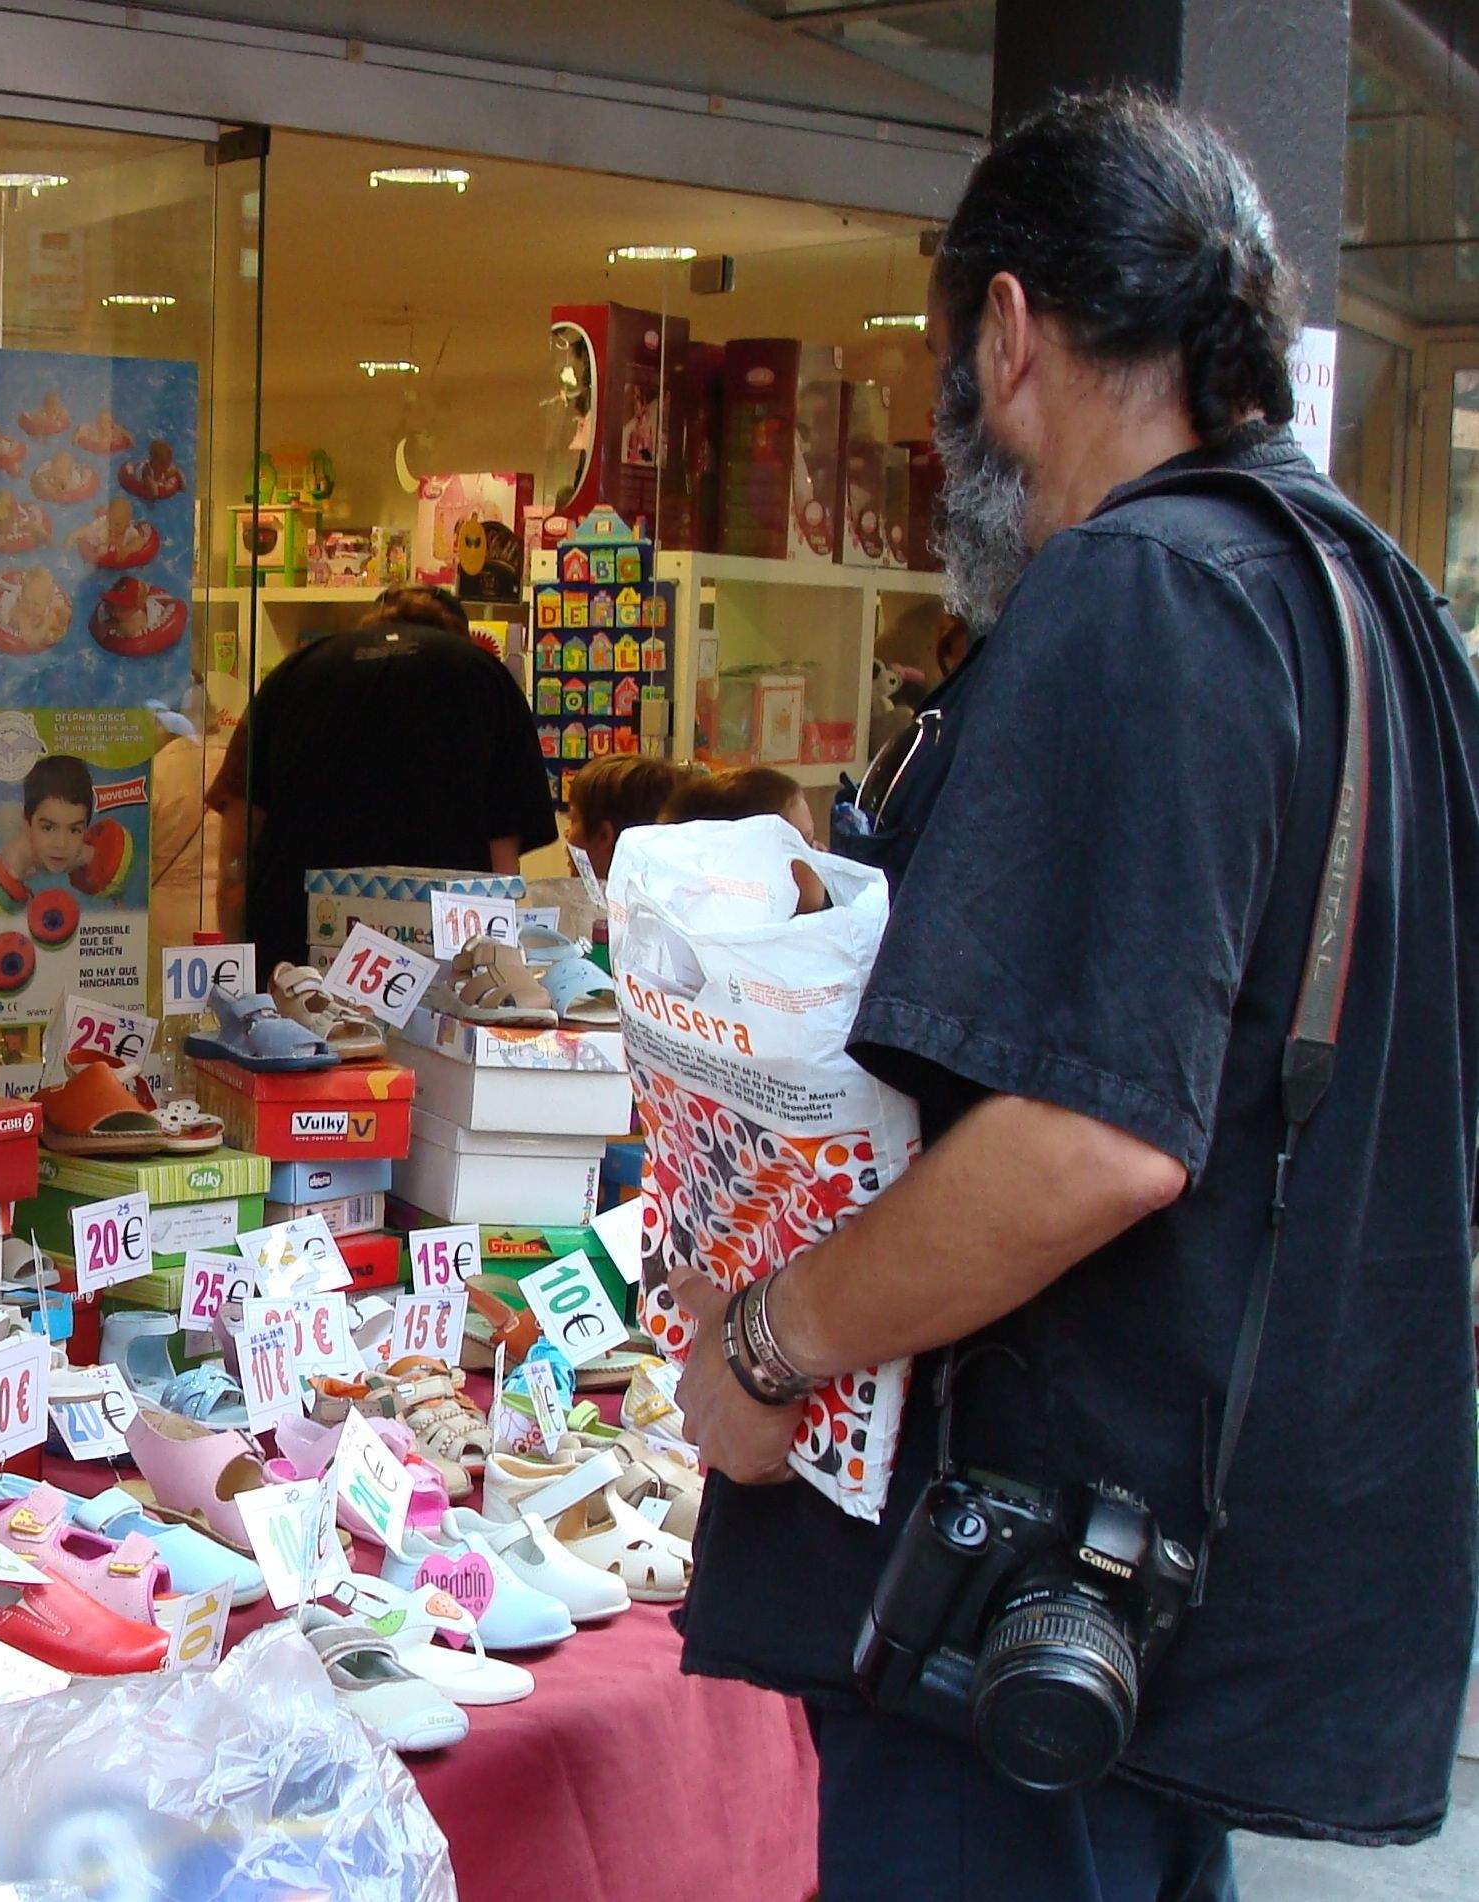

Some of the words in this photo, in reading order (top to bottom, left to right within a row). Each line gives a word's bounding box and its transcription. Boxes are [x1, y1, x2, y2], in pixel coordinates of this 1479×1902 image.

[99, 786, 142, 802] NOVEDAD
[79, 925, 130, 936] IMPOSIBLE
[79, 936, 97, 946] QUE
[101, 936, 114, 946] SE
[79, 946, 123, 957] PINCHEN
[79, 968, 93, 978] NO
[96, 967, 117, 977] HAY
[119, 967, 137, 977] QUE
[346, 948, 416, 1009] 15€
[79, 977, 140, 988] HINCHARLOS
[625, 975, 754, 1057] bolsera
[296, 1115, 345, 1132] Vulky
[190, 1168, 222, 1188] Falky
[86, 1215, 146, 1271] 20€
[417, 1241, 474, 1287] 15€
[539, 1266, 606, 1347] 10€
[1078, 1546, 1134, 1579] Canon
